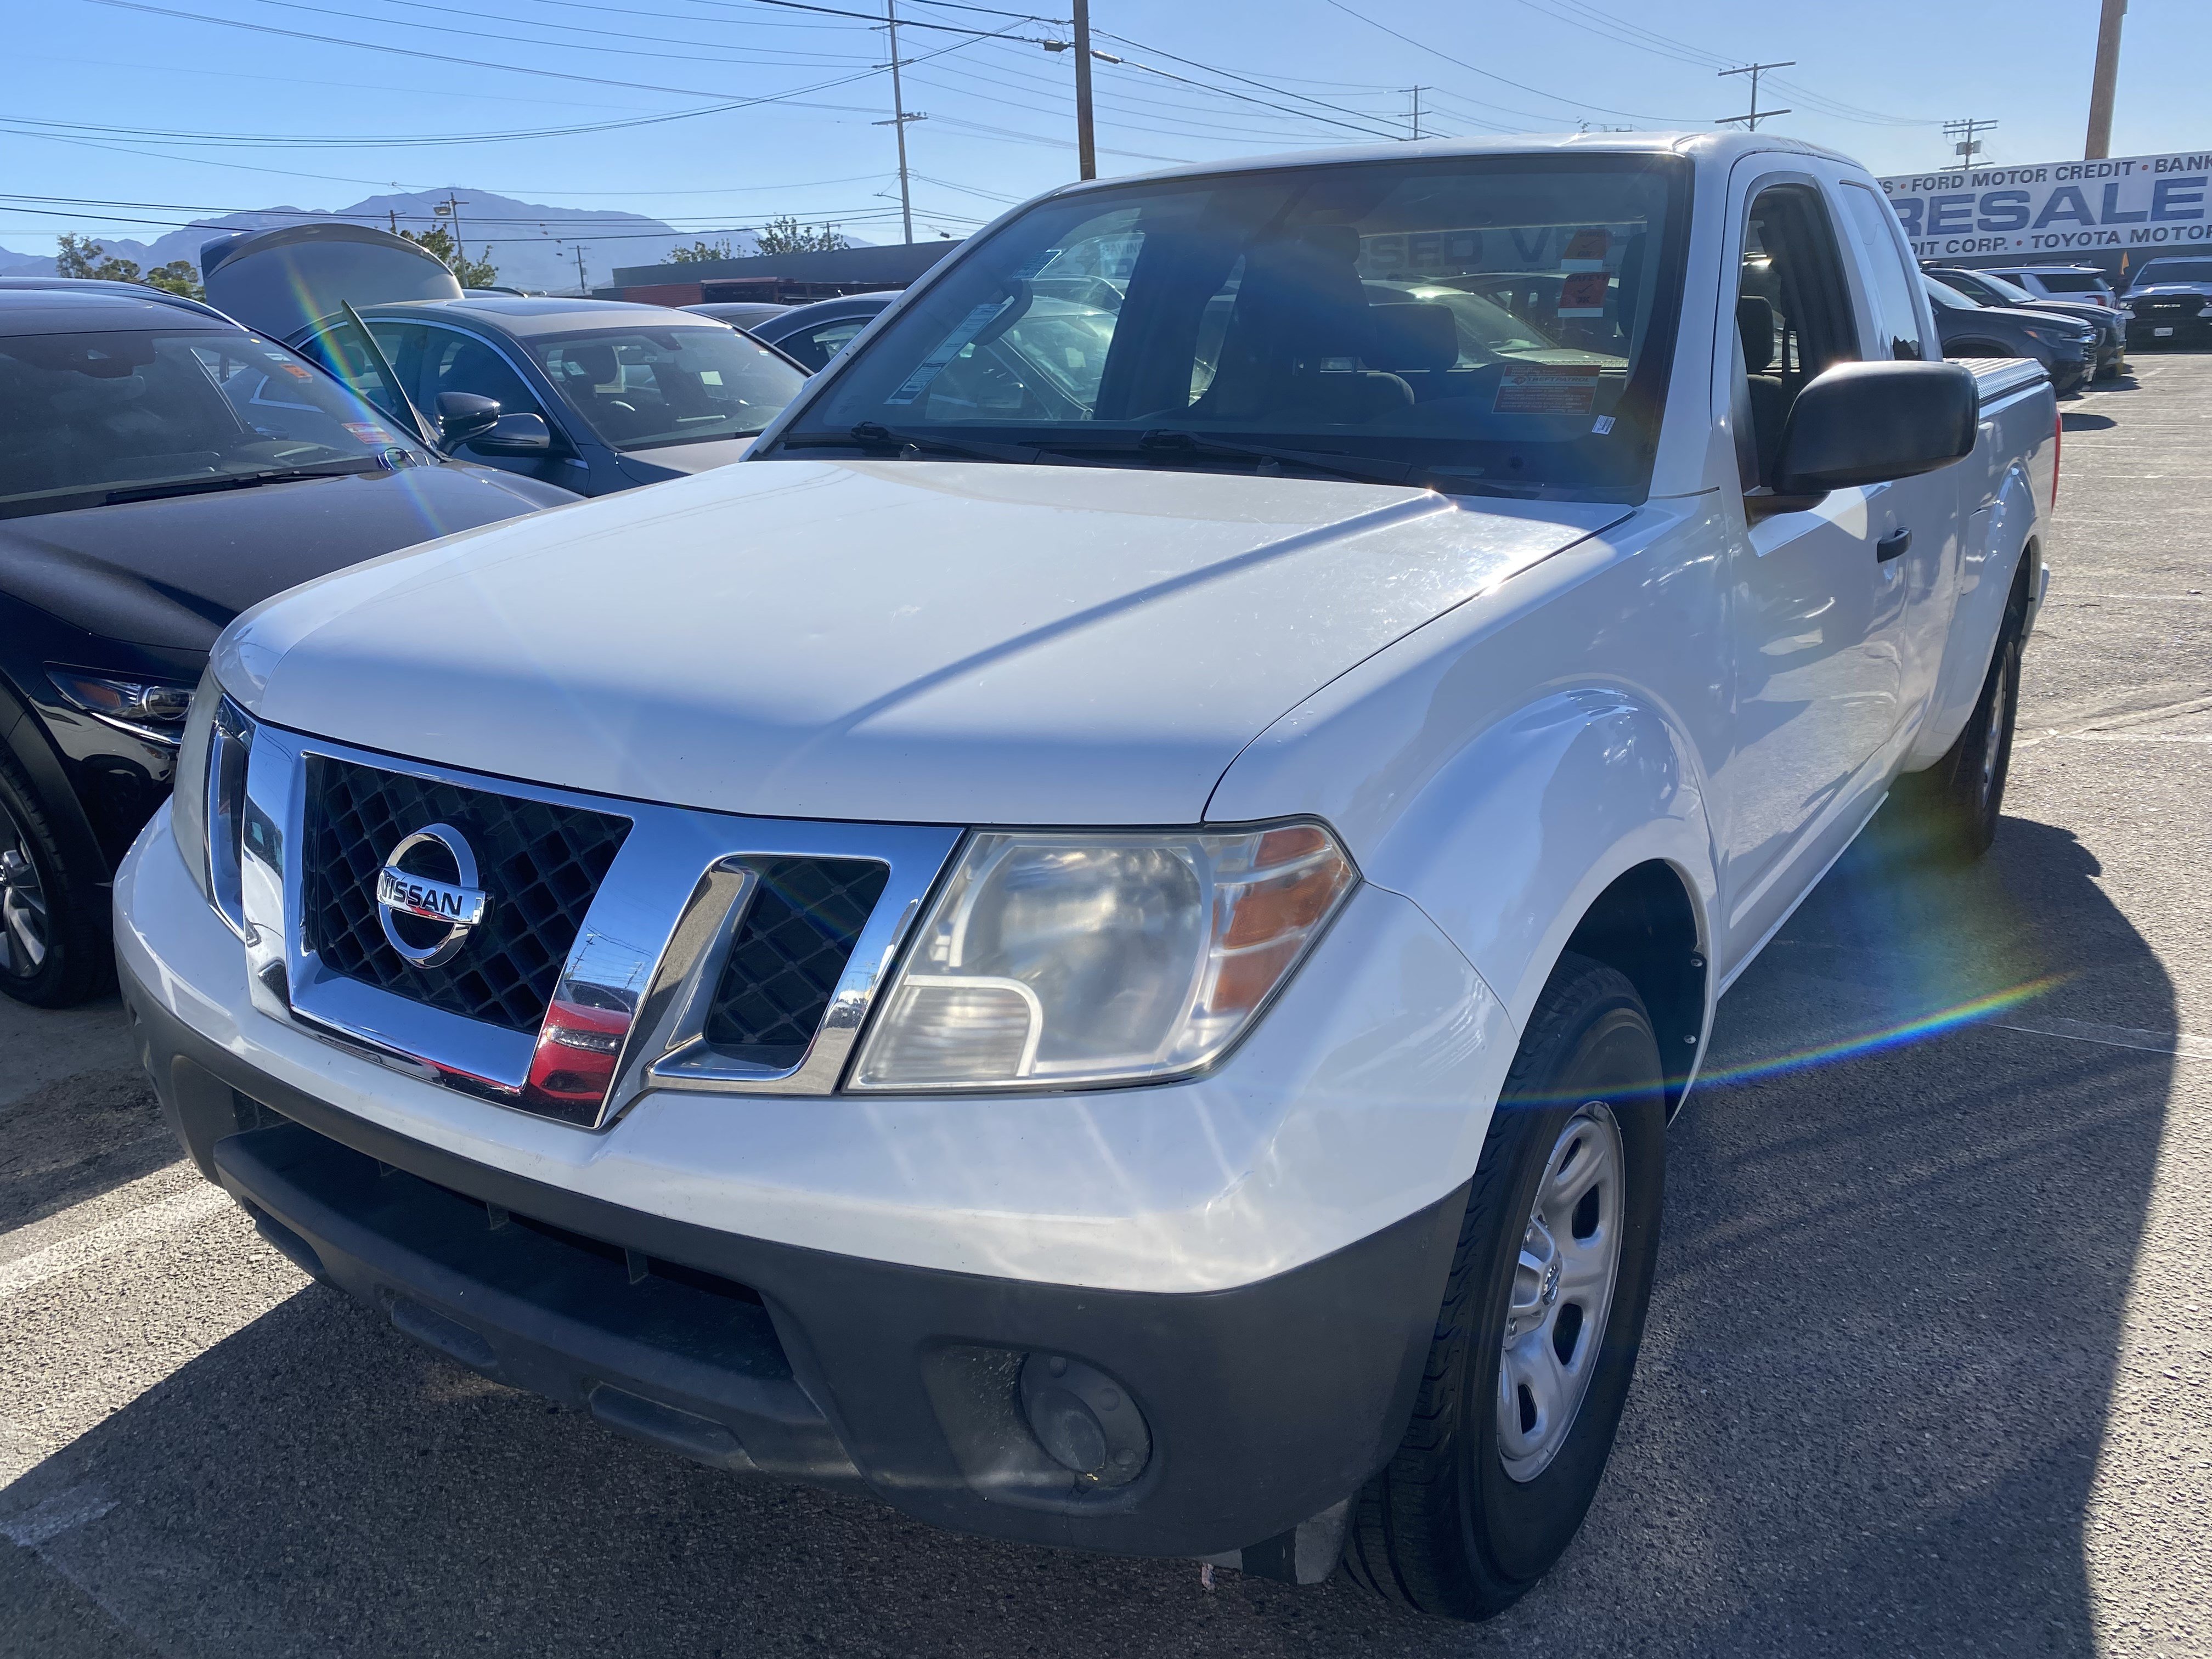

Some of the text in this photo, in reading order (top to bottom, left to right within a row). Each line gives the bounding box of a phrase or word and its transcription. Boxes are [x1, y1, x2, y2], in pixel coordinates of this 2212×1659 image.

[1878, 180, 1893, 194] S
[1912, 175, 1964, 192] FORD
[1971, 168, 2048, 187] MOTOR
[2056, 161, 2136, 180] CREDIT
[1890, 176, 2208, 236] RESALE
[1361, 232, 1482, 270] SED
[1946, 237, 2008, 253] CORP.
[2031, 230, 2121, 249] TOYOTA
[377, 874, 463, 916] NISSAN
